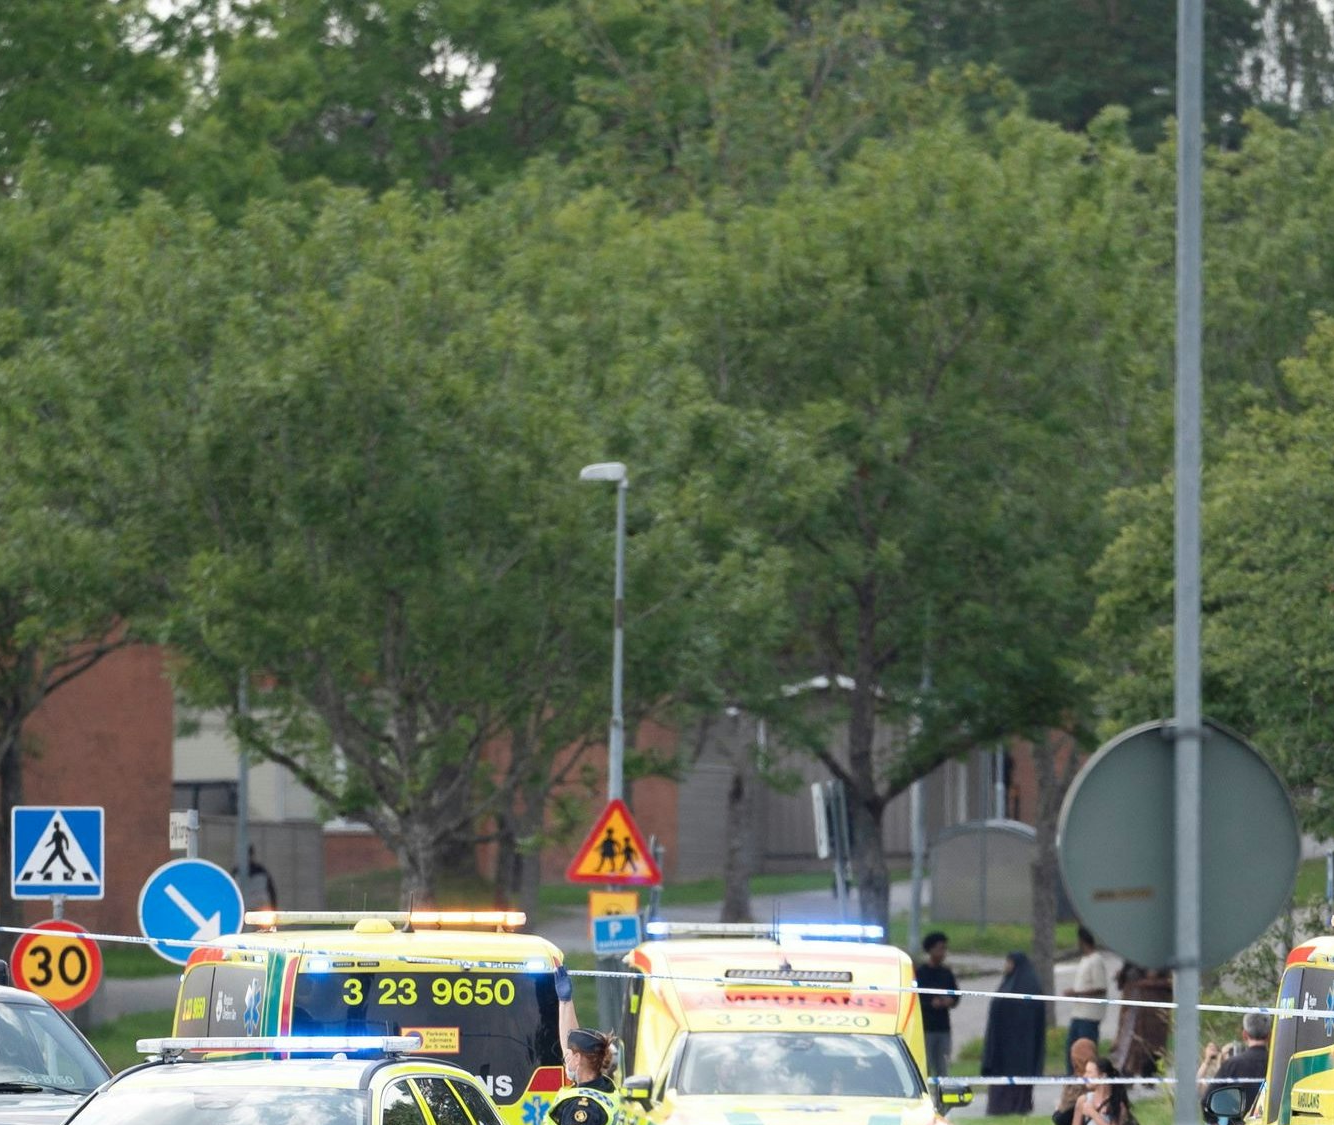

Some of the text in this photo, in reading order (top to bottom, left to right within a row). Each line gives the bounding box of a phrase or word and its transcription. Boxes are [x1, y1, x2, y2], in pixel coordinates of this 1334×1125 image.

[29, 945, 87, 987] 30
[343, 978, 515, 1005] 3 23 9650
[716, 1013, 871, 1028] 3 23 9220
